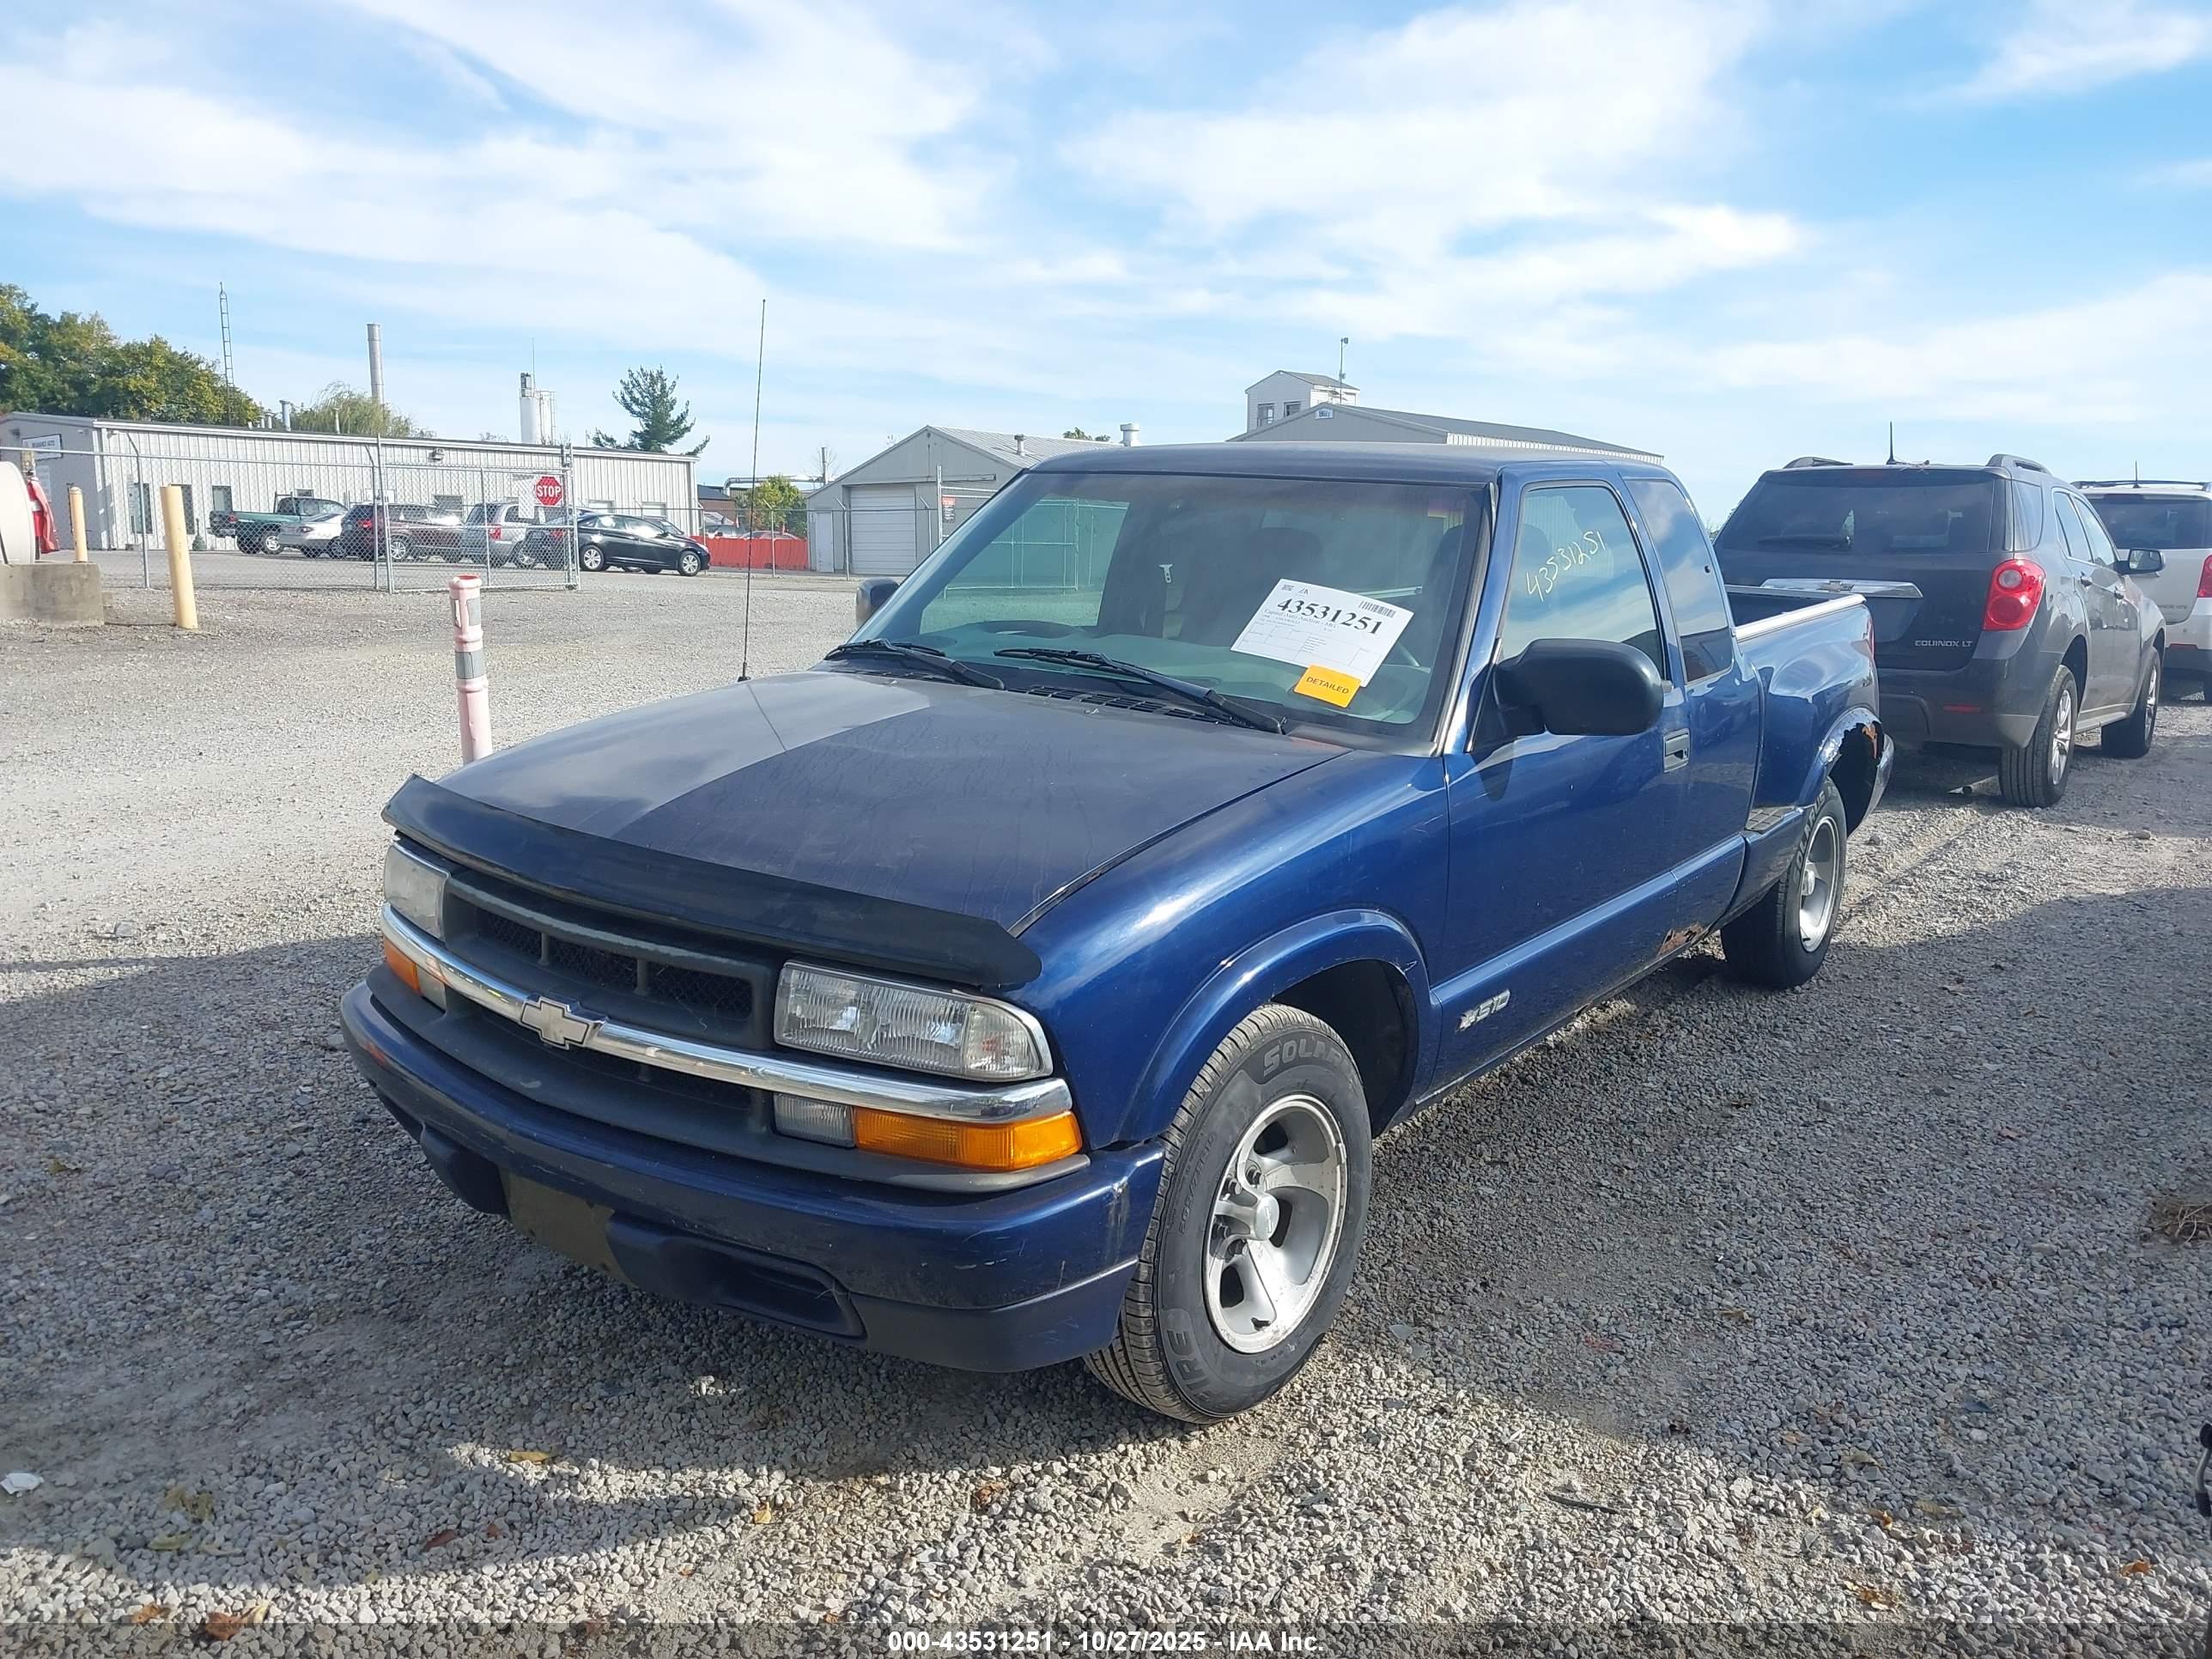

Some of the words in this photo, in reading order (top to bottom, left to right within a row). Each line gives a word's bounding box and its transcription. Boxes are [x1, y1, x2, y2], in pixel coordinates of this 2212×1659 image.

[537, 485, 561, 497] STOP
[1526, 531, 1606, 602] 43531251
[1277, 598, 1382, 635] 43531251
[1305, 676, 1349, 695] DETAILED
